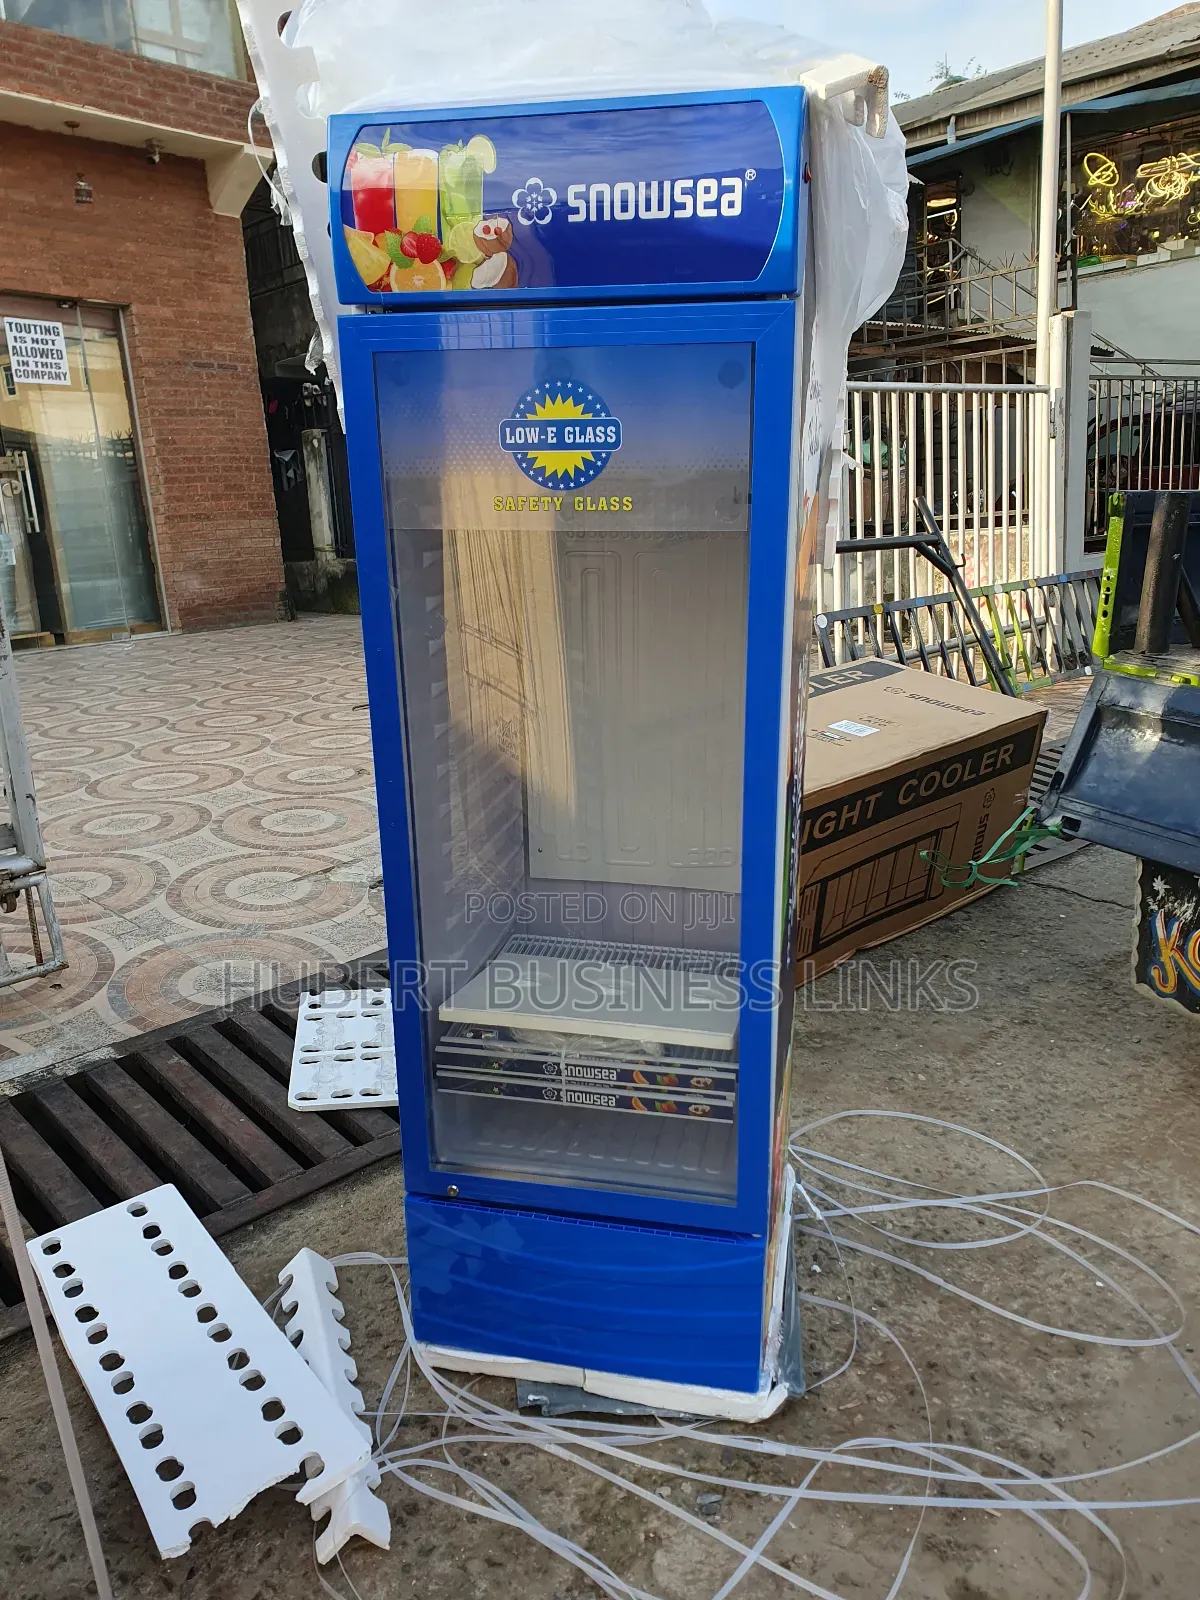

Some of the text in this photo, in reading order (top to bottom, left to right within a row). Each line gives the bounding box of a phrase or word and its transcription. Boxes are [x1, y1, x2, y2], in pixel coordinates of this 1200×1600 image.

[6, 321, 61, 337] TOUTING
[13, 335, 57, 346] IS NOT
[12, 345, 64, 360] ALLOWED
[17, 359, 61, 370] IN THIS
[15, 368, 67, 381] COMPANY
[505, 426, 616, 444] LOW-E GLASS
[493, 496, 633, 511] SAFETY GLASS
[809, 670, 874, 694] LER
[898, 743, 1014, 805] COOLER
